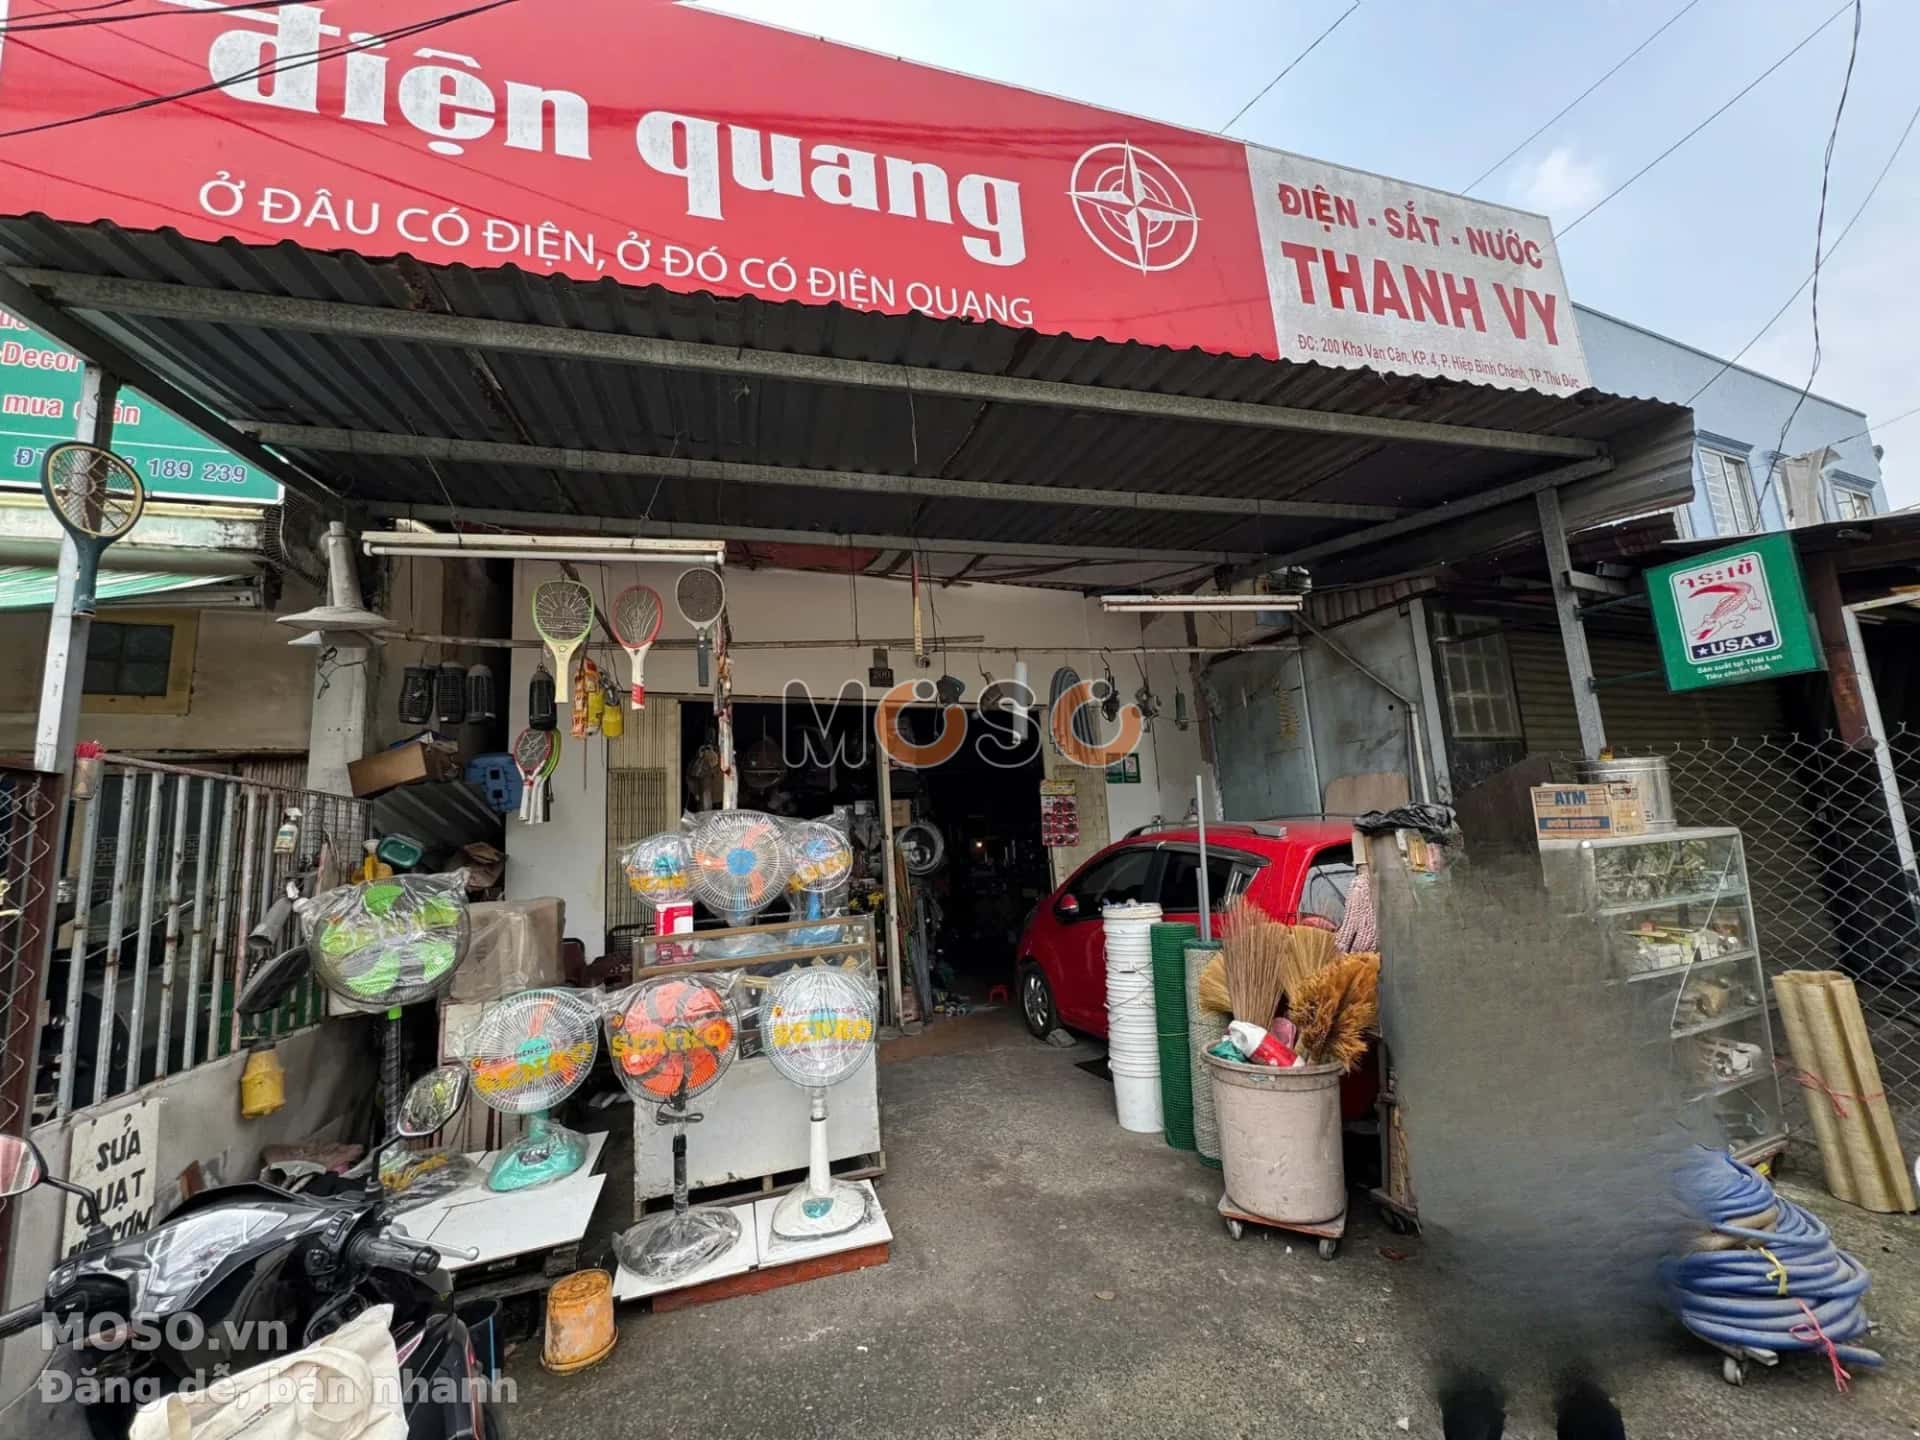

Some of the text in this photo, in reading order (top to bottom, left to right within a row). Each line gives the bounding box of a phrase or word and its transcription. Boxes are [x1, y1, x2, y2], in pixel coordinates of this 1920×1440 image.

[205, 1, 1027, 267] điện quang
[198, 169, 1034, 326] Ở ĐÂU CÓ ĐIỆN, Ở ĐÓ CÓ ĐIỆN QUANG
[1278, 183, 1359, 232] ĐIỆN
[1384, 201, 1440, 246] SẮT
[1466, 226, 1543, 269] NƯỚC
[1281, 240, 1559, 346] THANH VY
[1298, 334, 1319, 351] ĐC:
[1320, 337, 1340, 354] 200
[1341, 341, 1363, 357] Kha
[1412, 348, 1430, 366] KP.
[1441, 354, 1451, 368] P.
[3, 395, 64, 418] mua
[149, 459, 192, 479] 189
[202, 463, 248, 483] 239
[1710, 636, 1755, 654] USA
[1555, 790, 1587, 806] ATM
[611, 1018, 728, 1057] SENKO
[96, 1113, 141, 1172] SỬA
[76, 1168, 146, 1227] QUẠT
